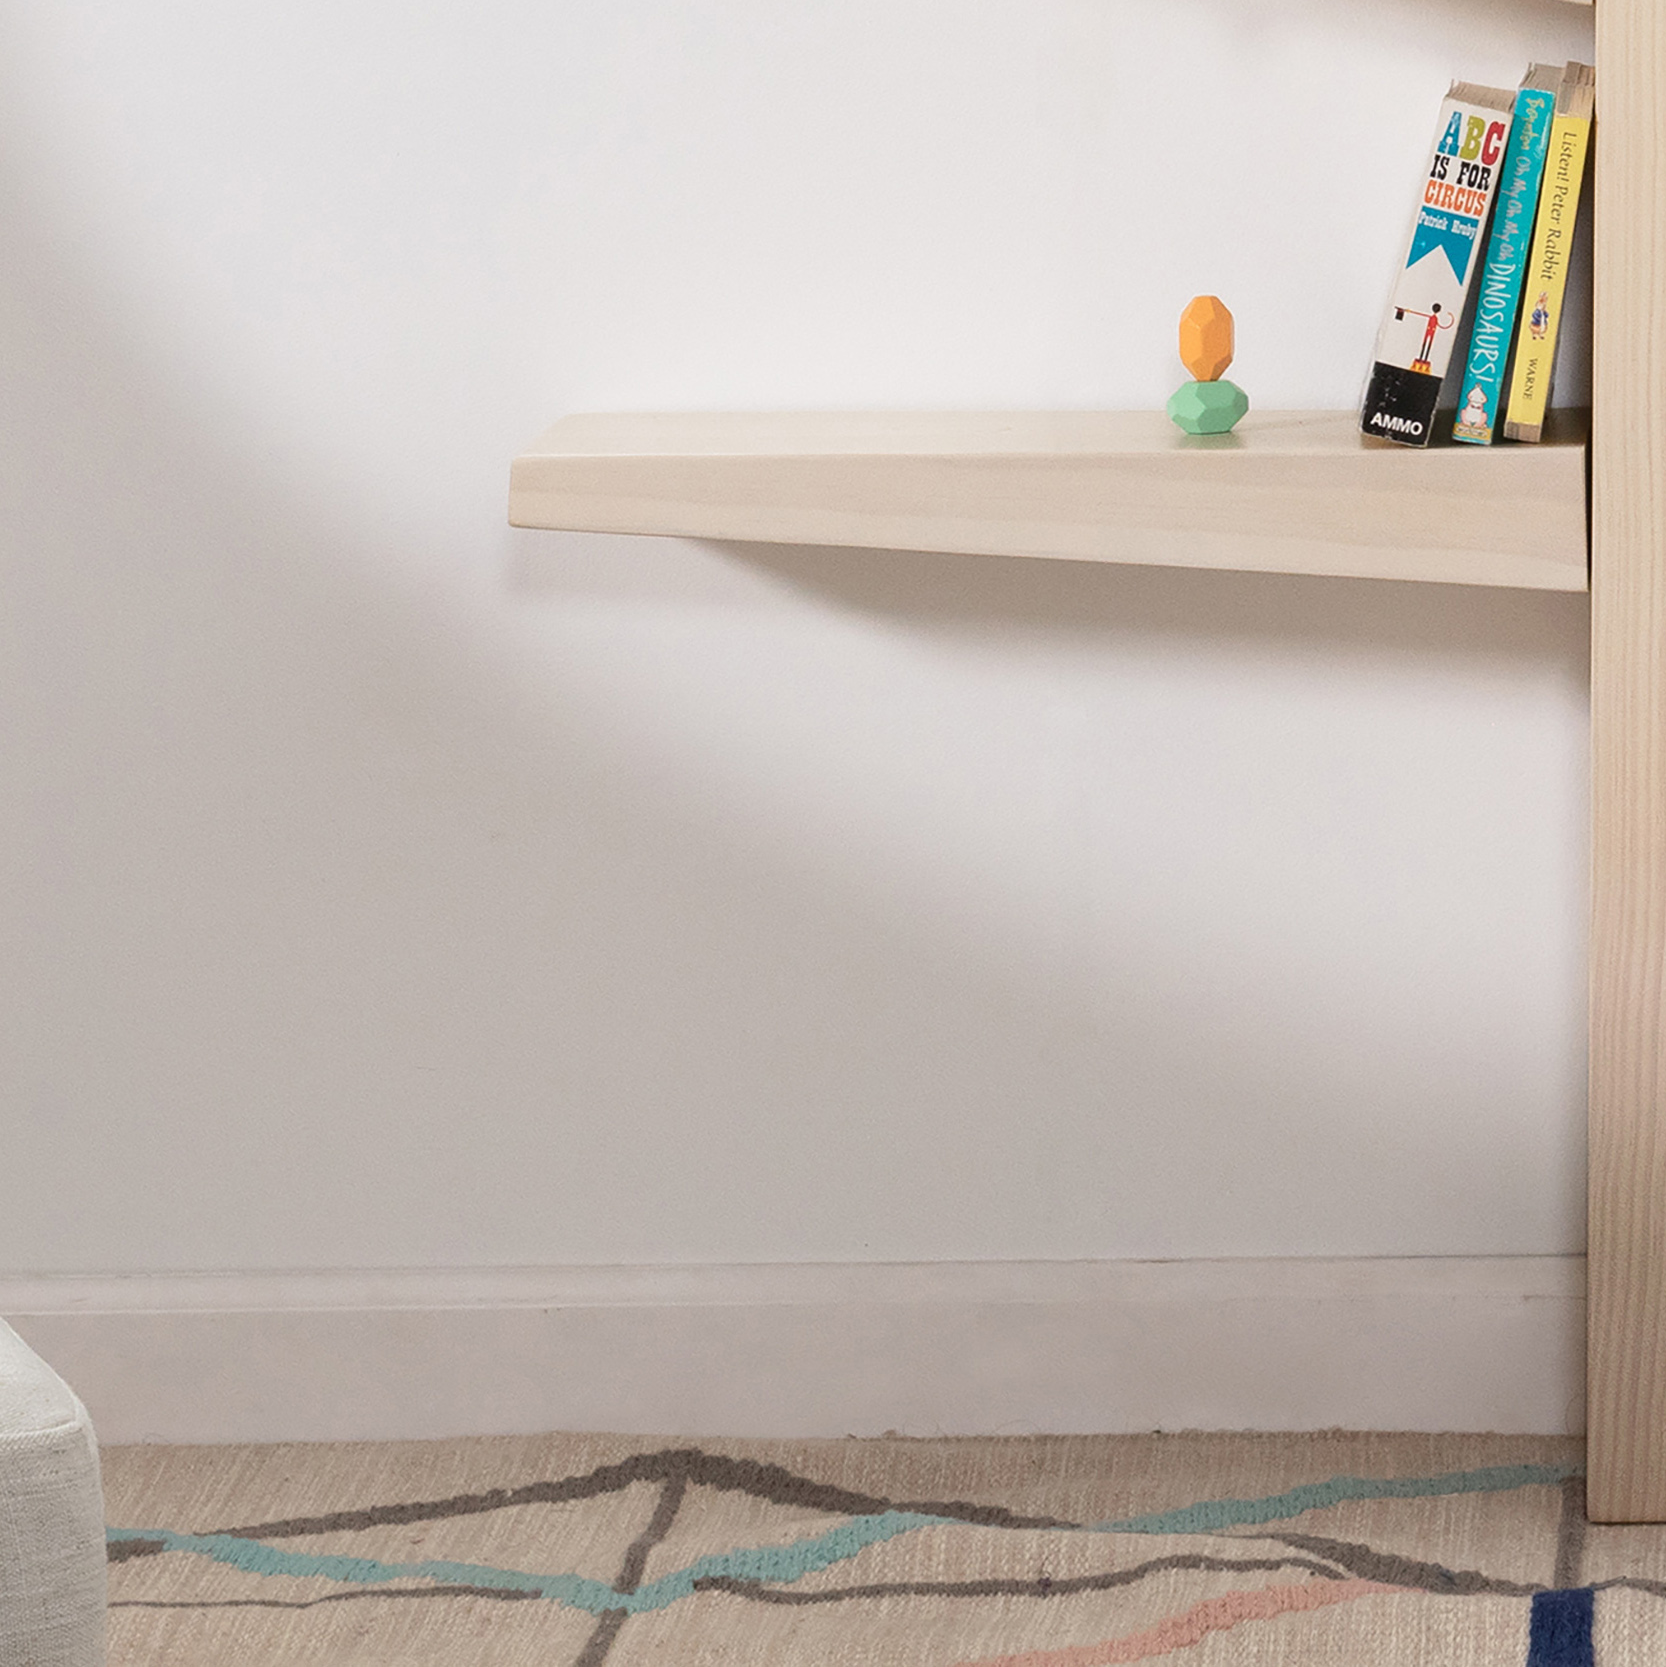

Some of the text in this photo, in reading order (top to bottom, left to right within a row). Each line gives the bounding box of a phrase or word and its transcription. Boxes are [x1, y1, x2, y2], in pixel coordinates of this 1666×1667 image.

[1438, 111, 1505, 165] ABC
[1429, 154, 1493, 192] IS FOR
[1424, 179, 1487, 217] CIRCUS
[1539, 131, 1577, 280] Listen! Peter Rabbit
[1417, 210, 1449, 232] Patrick
[1469, 156, 1531, 382] Oh My Oh My Oh DINOSAURS!
[1522, 358, 1538, 401] WARNE
[1370, 411, 1423, 436] AMMO
